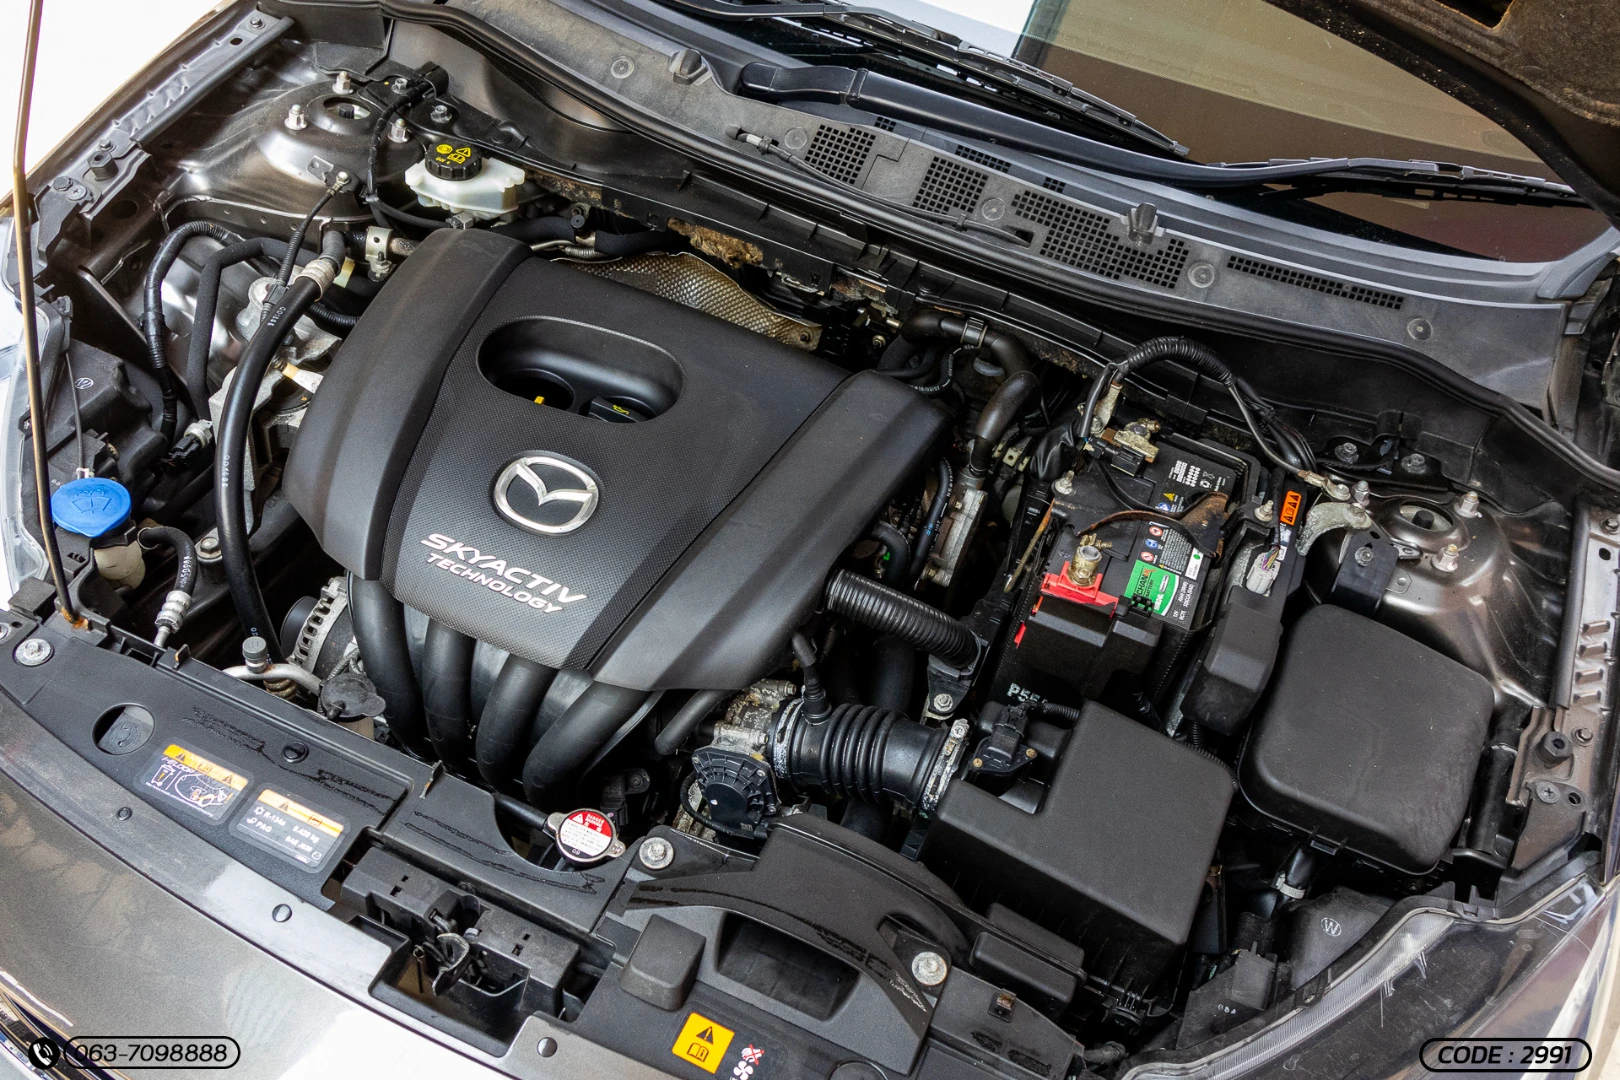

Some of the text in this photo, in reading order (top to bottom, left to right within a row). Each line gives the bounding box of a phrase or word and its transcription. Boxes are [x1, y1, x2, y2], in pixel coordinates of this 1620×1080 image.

[420, 533, 588, 604] SKYACTIV
[426, 552, 563, 614] TECHNOLOGY
[585, 813, 605, 825] DANGER
[255, 820, 273, 833] PAG
[310, 833, 320, 844] kg
